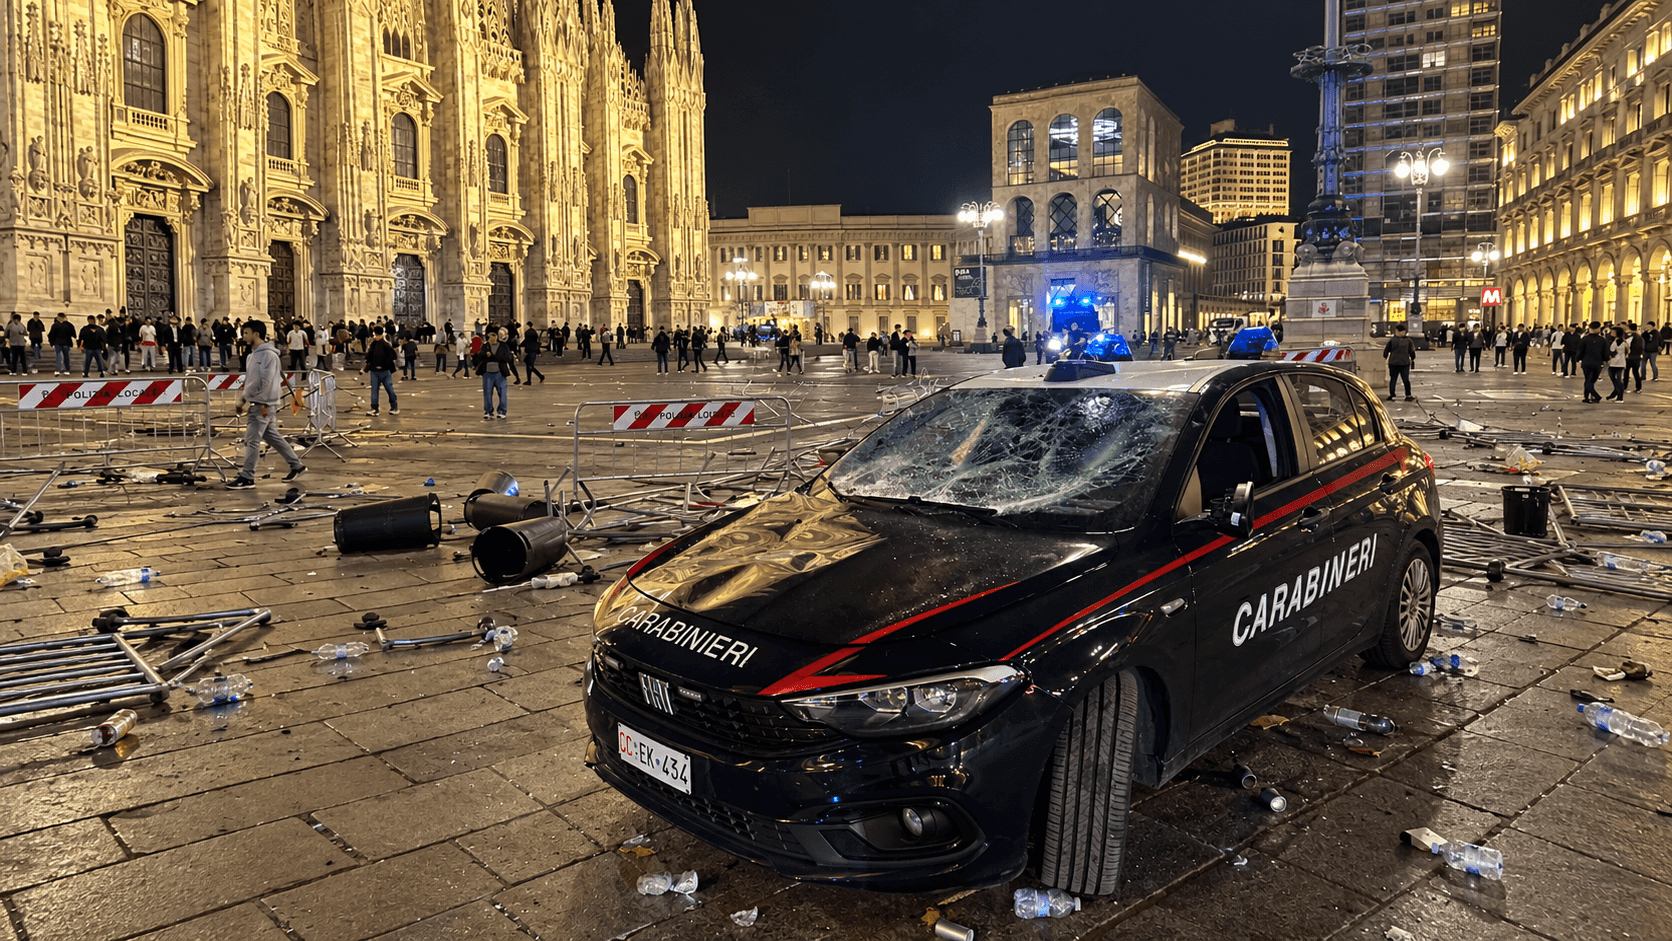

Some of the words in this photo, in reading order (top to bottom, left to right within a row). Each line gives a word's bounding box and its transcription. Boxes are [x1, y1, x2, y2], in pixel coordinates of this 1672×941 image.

[1482, 289, 1500, 303] M
[1232, 532, 1378, 647] CARABINERI
[617, 606, 758, 668] CARABINIERI
